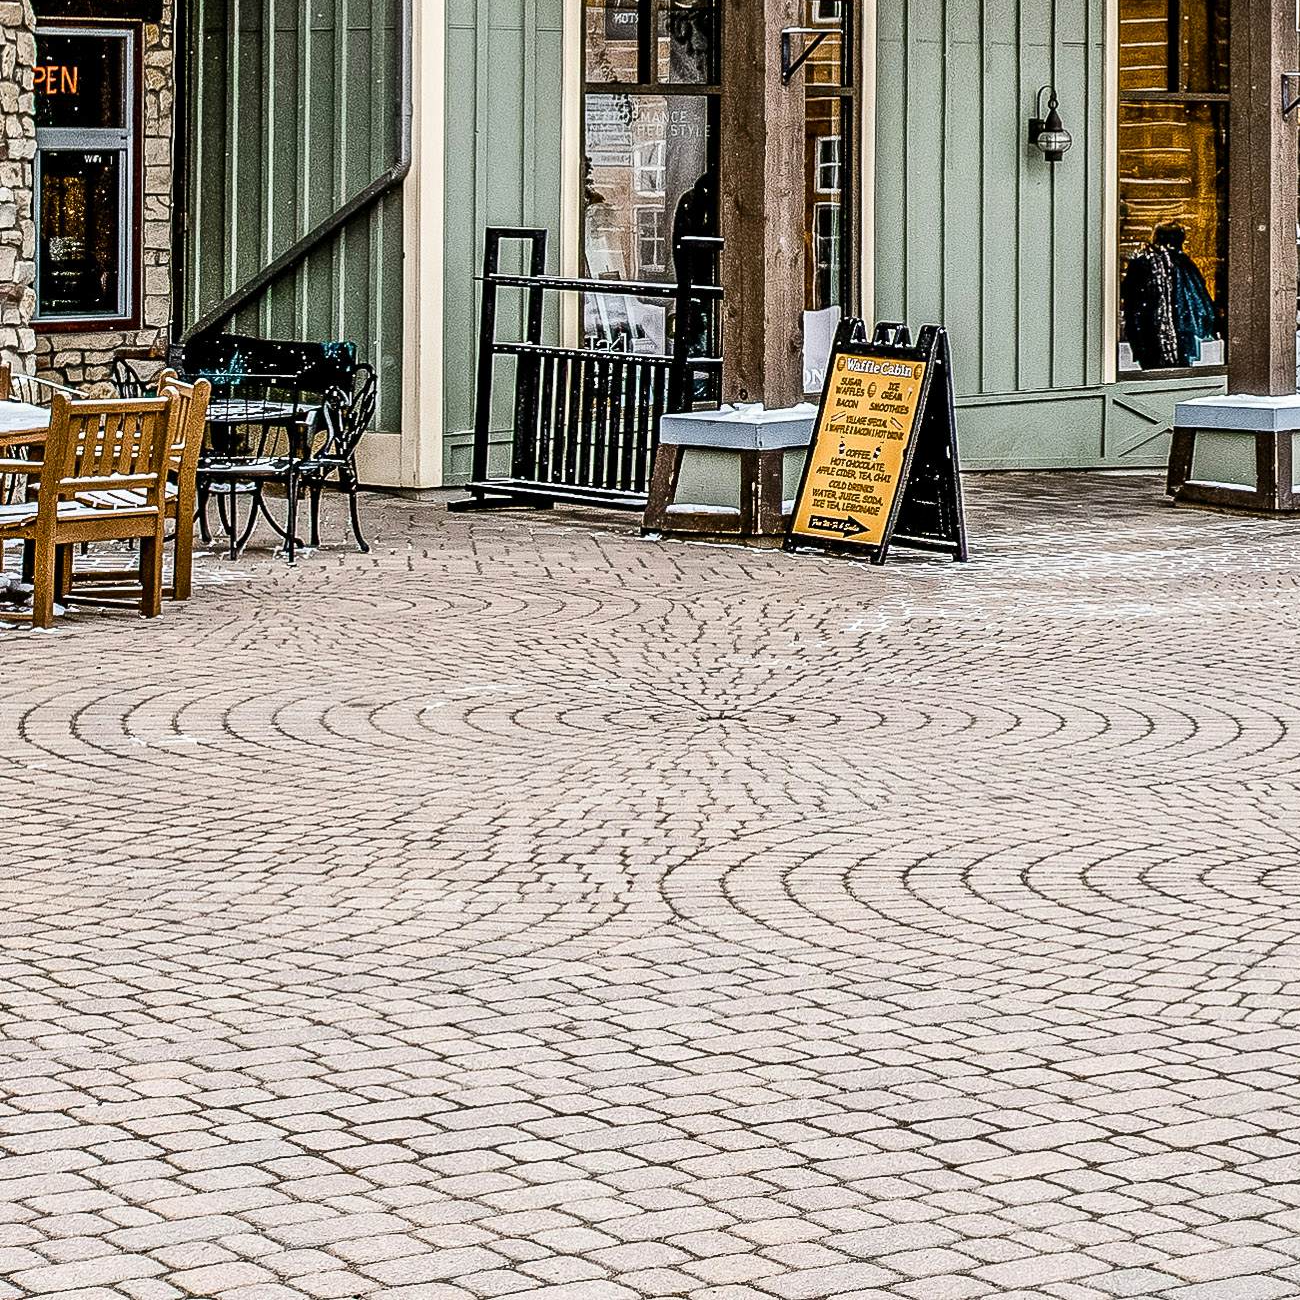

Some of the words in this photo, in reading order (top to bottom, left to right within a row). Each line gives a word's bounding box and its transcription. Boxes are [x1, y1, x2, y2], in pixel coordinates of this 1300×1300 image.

[33, 66, 78, 94] PEN
[846, 357, 880, 374] Waffle
[880, 361, 913, 378] Cabin
[840, 377, 863, 387] SUGAR
[836, 385, 865, 397] WAFFLES
[881, 391, 903, 401] CREAM
[836, 398, 859, 409] BACON
[869, 402, 909, 415] SMOOTHIES
[830, 457, 846, 466] HOT
[816, 466, 836, 476] APPLE
[829, 480, 847, 488] COLD
[847, 482, 874, 493] DRINKS
[812, 499, 825, 508] ICE
[842, 503, 881, 516] LEMONADE
